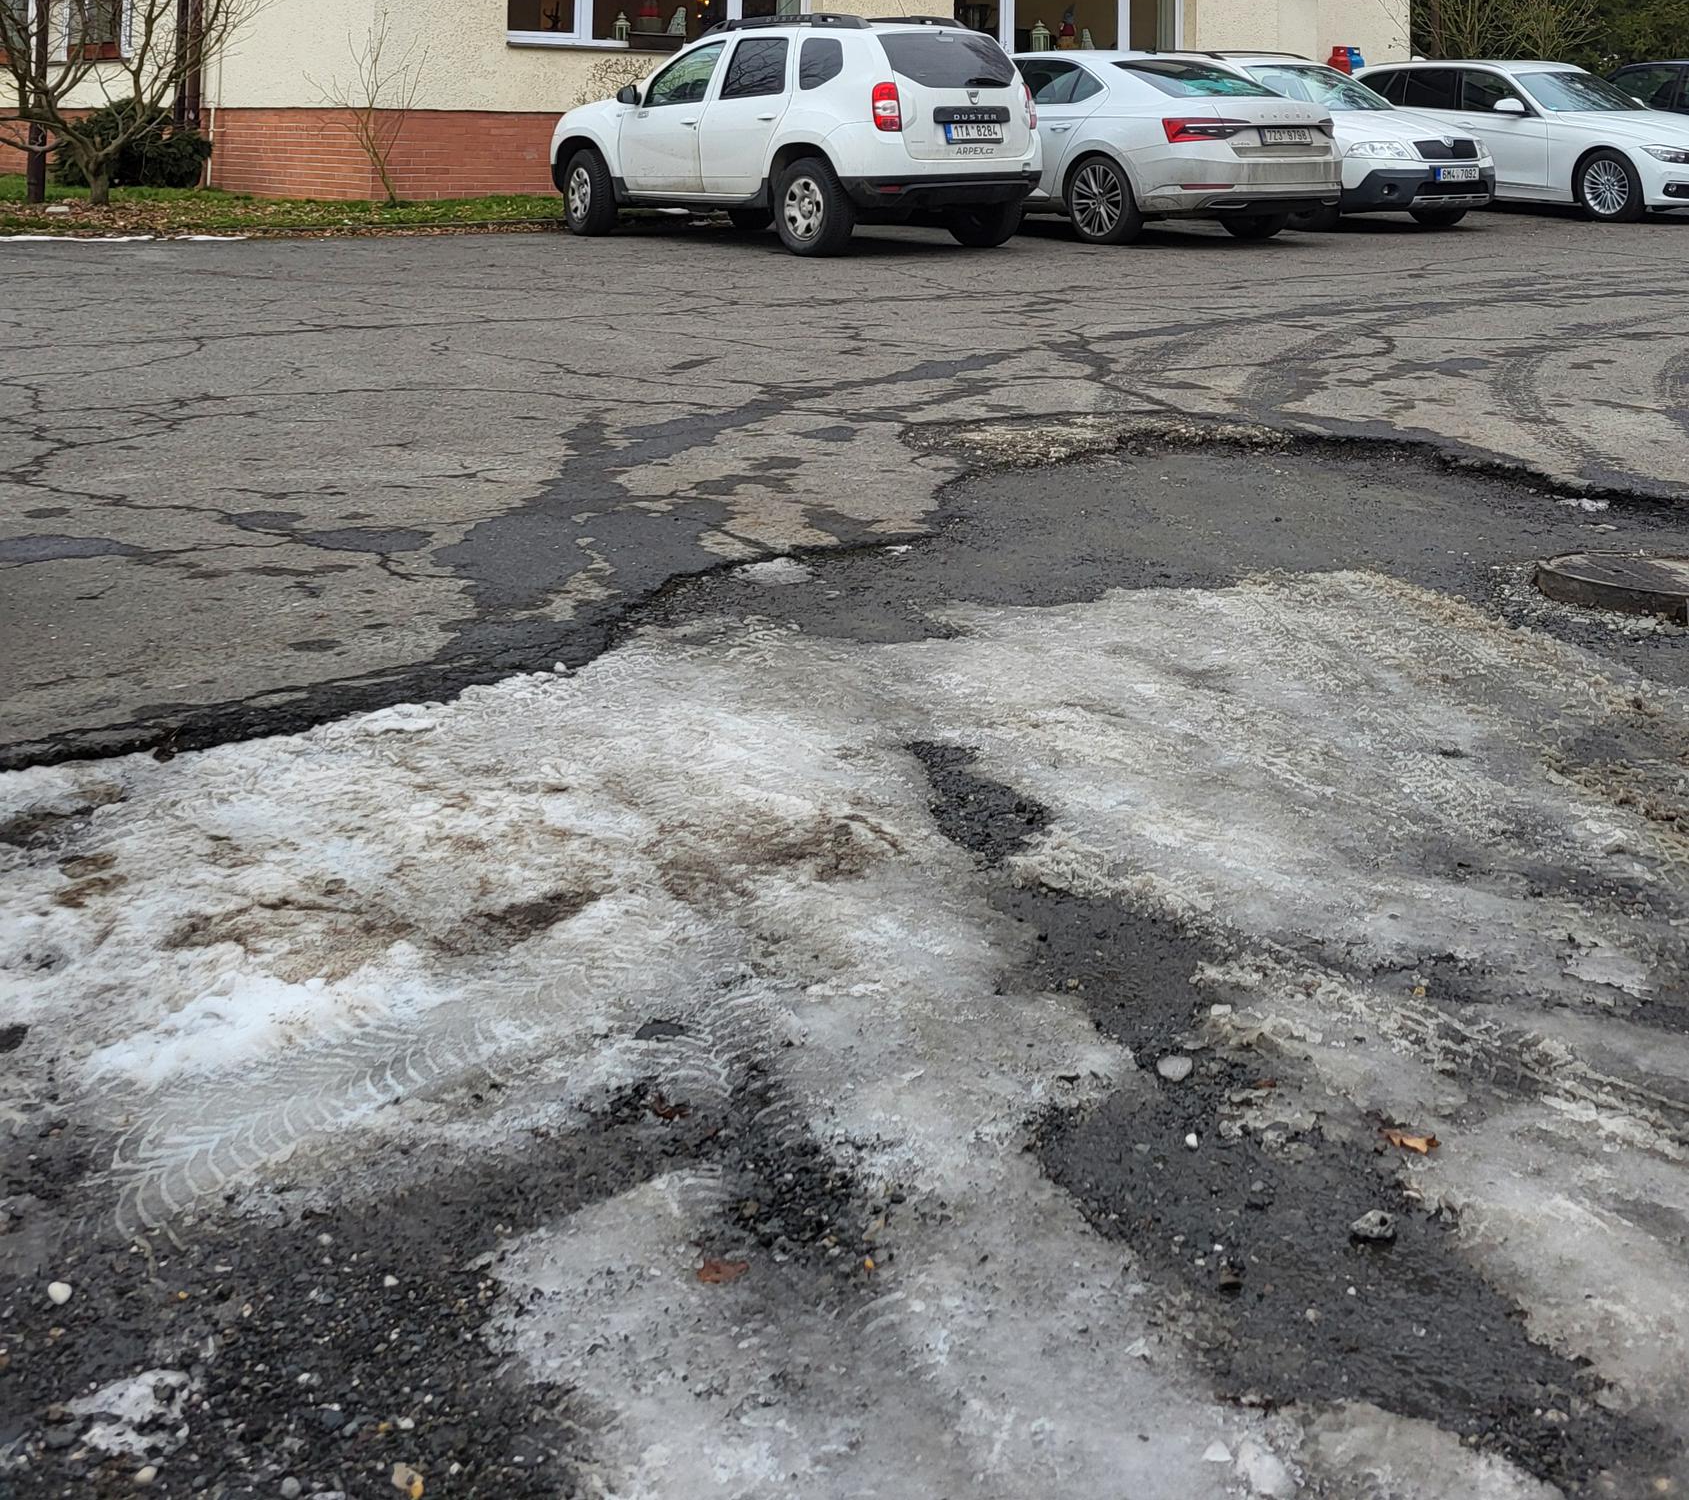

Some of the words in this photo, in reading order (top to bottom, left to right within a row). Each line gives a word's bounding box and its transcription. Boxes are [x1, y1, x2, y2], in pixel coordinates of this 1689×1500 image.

[953, 113, 997, 121] DUSTER
[954, 124, 970, 138] 1TA
[976, 124, 998, 137] 8284
[956, 147, 994, 155] ARPEX.cz
[1460, 168, 1477, 179] 7092
